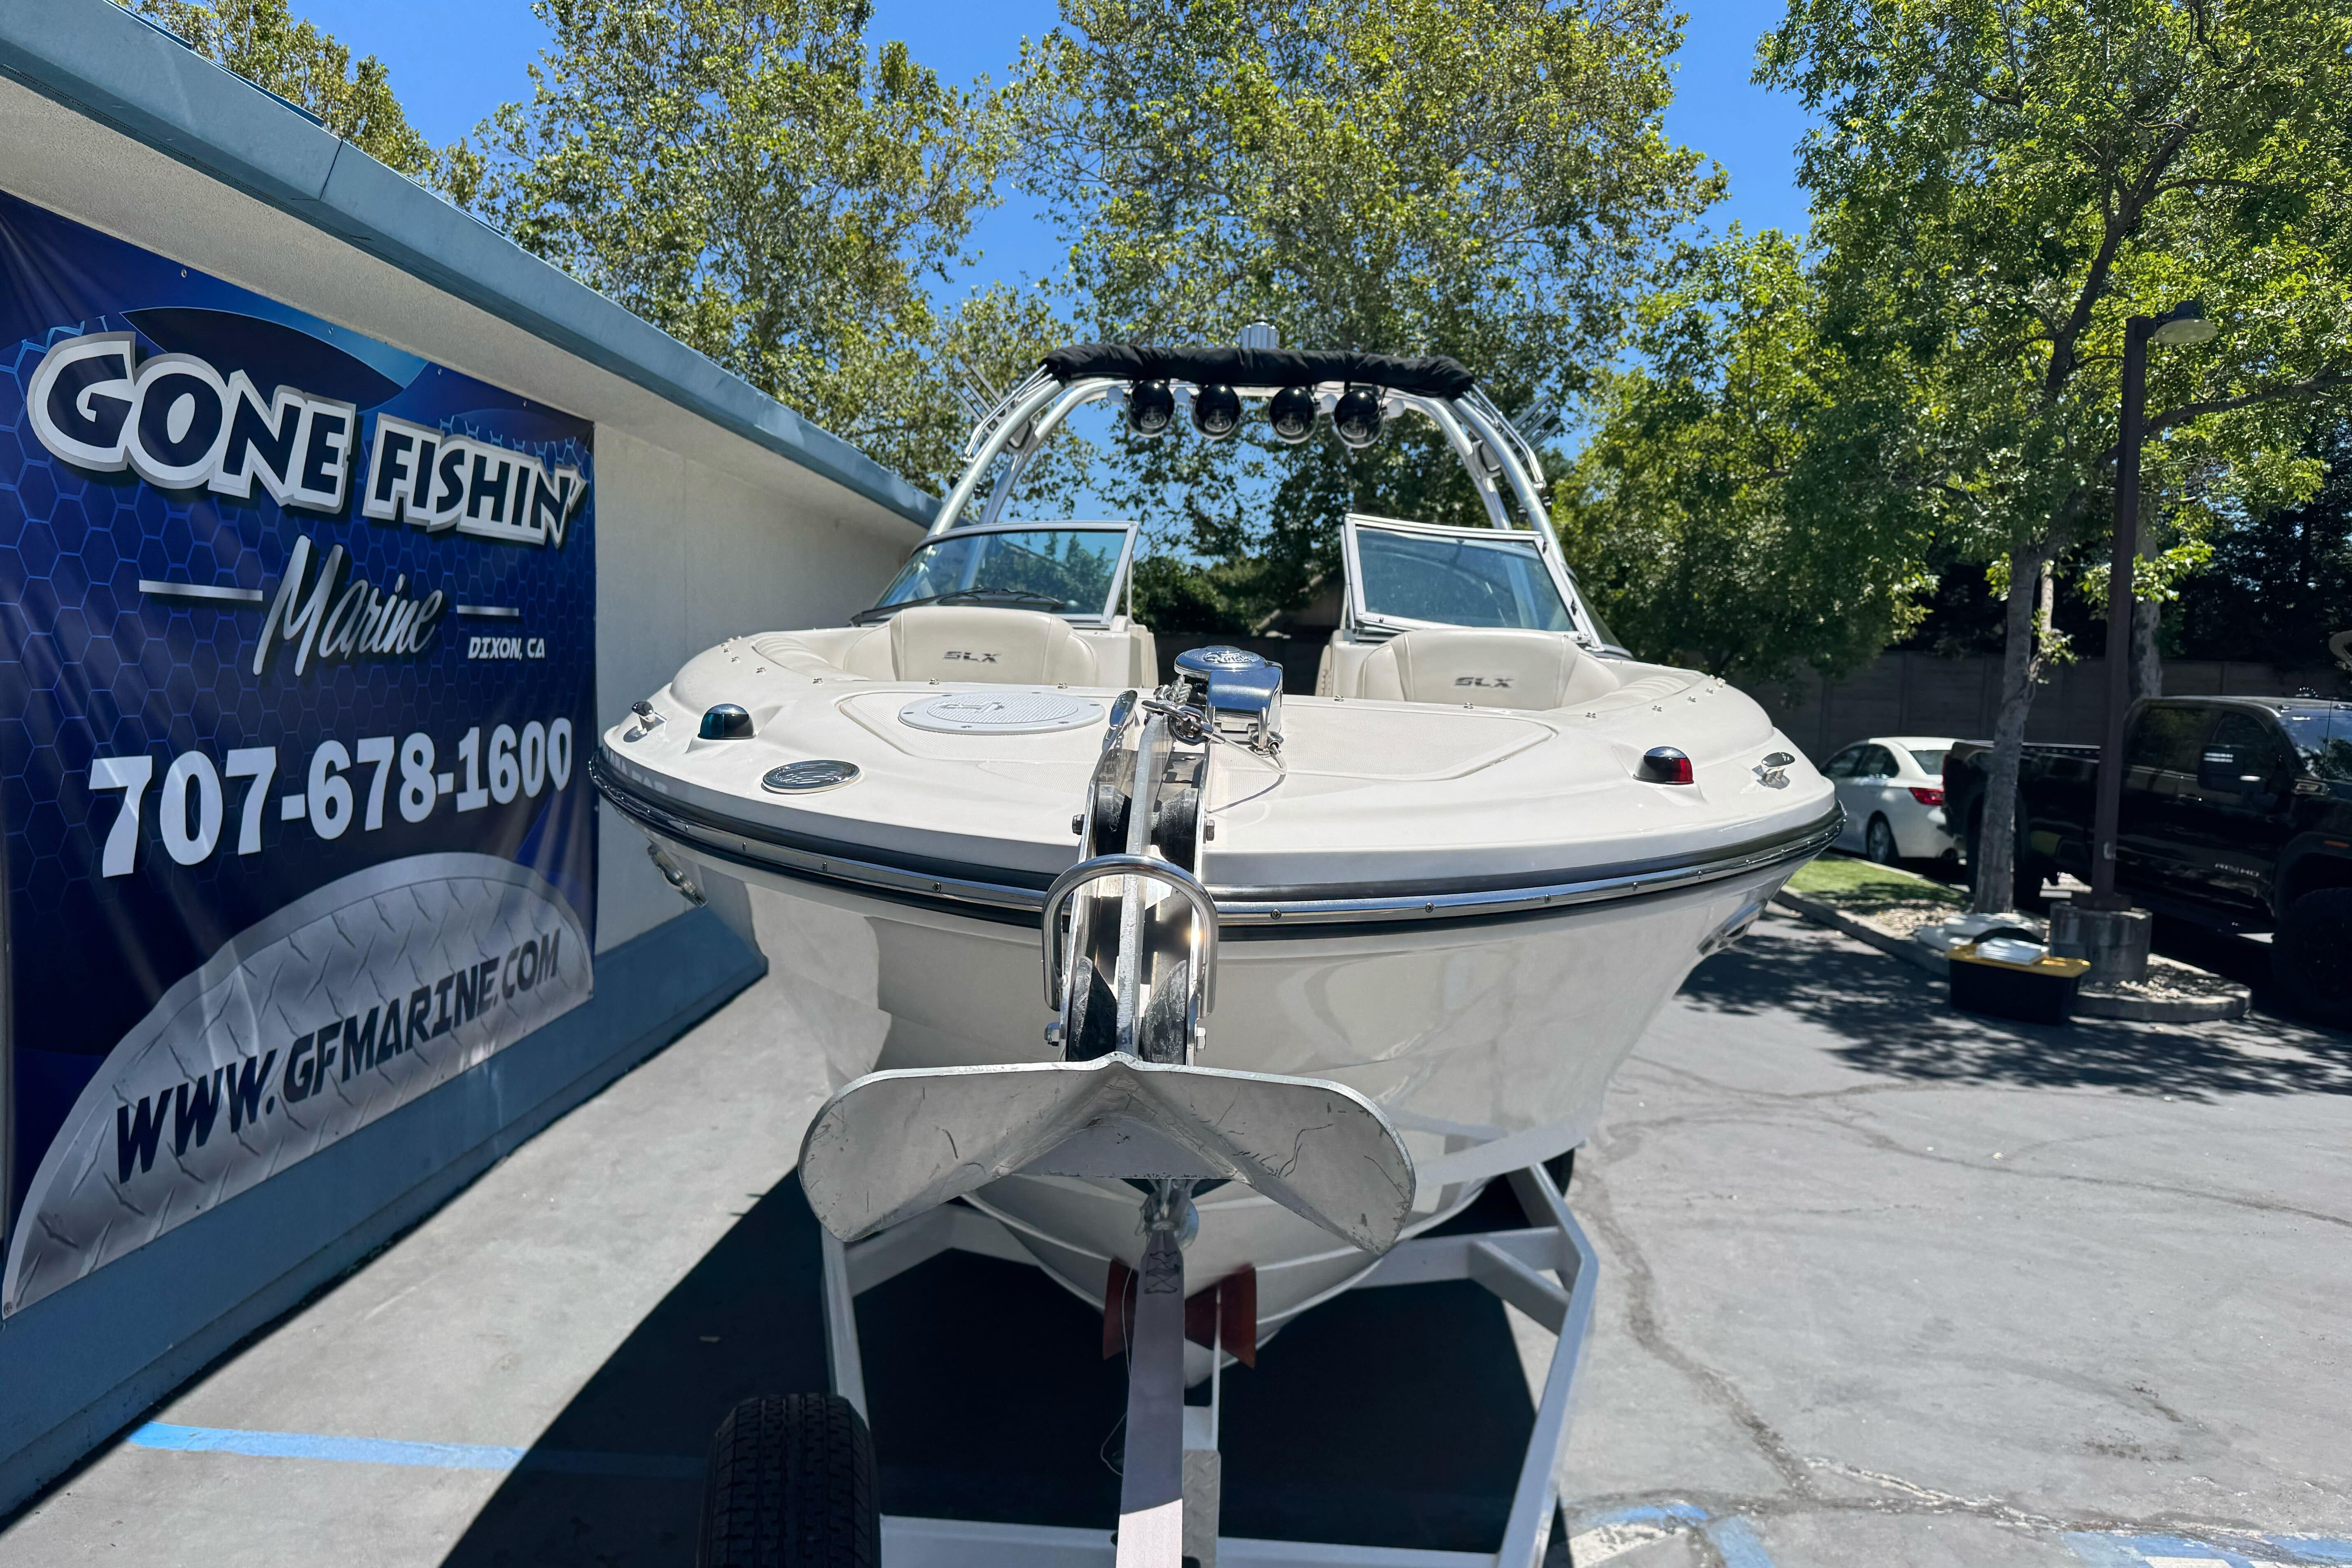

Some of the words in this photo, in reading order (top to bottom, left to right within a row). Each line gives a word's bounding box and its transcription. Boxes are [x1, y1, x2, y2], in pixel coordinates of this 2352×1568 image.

[30, 334, 355, 512] GONE
[363, 414, 586, 547] FISHIN'
[253, 535, 443, 676] Marine
[468, 637, 523, 660] DIXON,
[527, 638, 545, 658] CA
[943, 651, 1001, 663] SLX
[1455, 677, 1516, 688] SLX
[89, 717, 572, 877] 707-678-1600
[115, 929, 562, 1184] WWW.GFMARINE.COM
